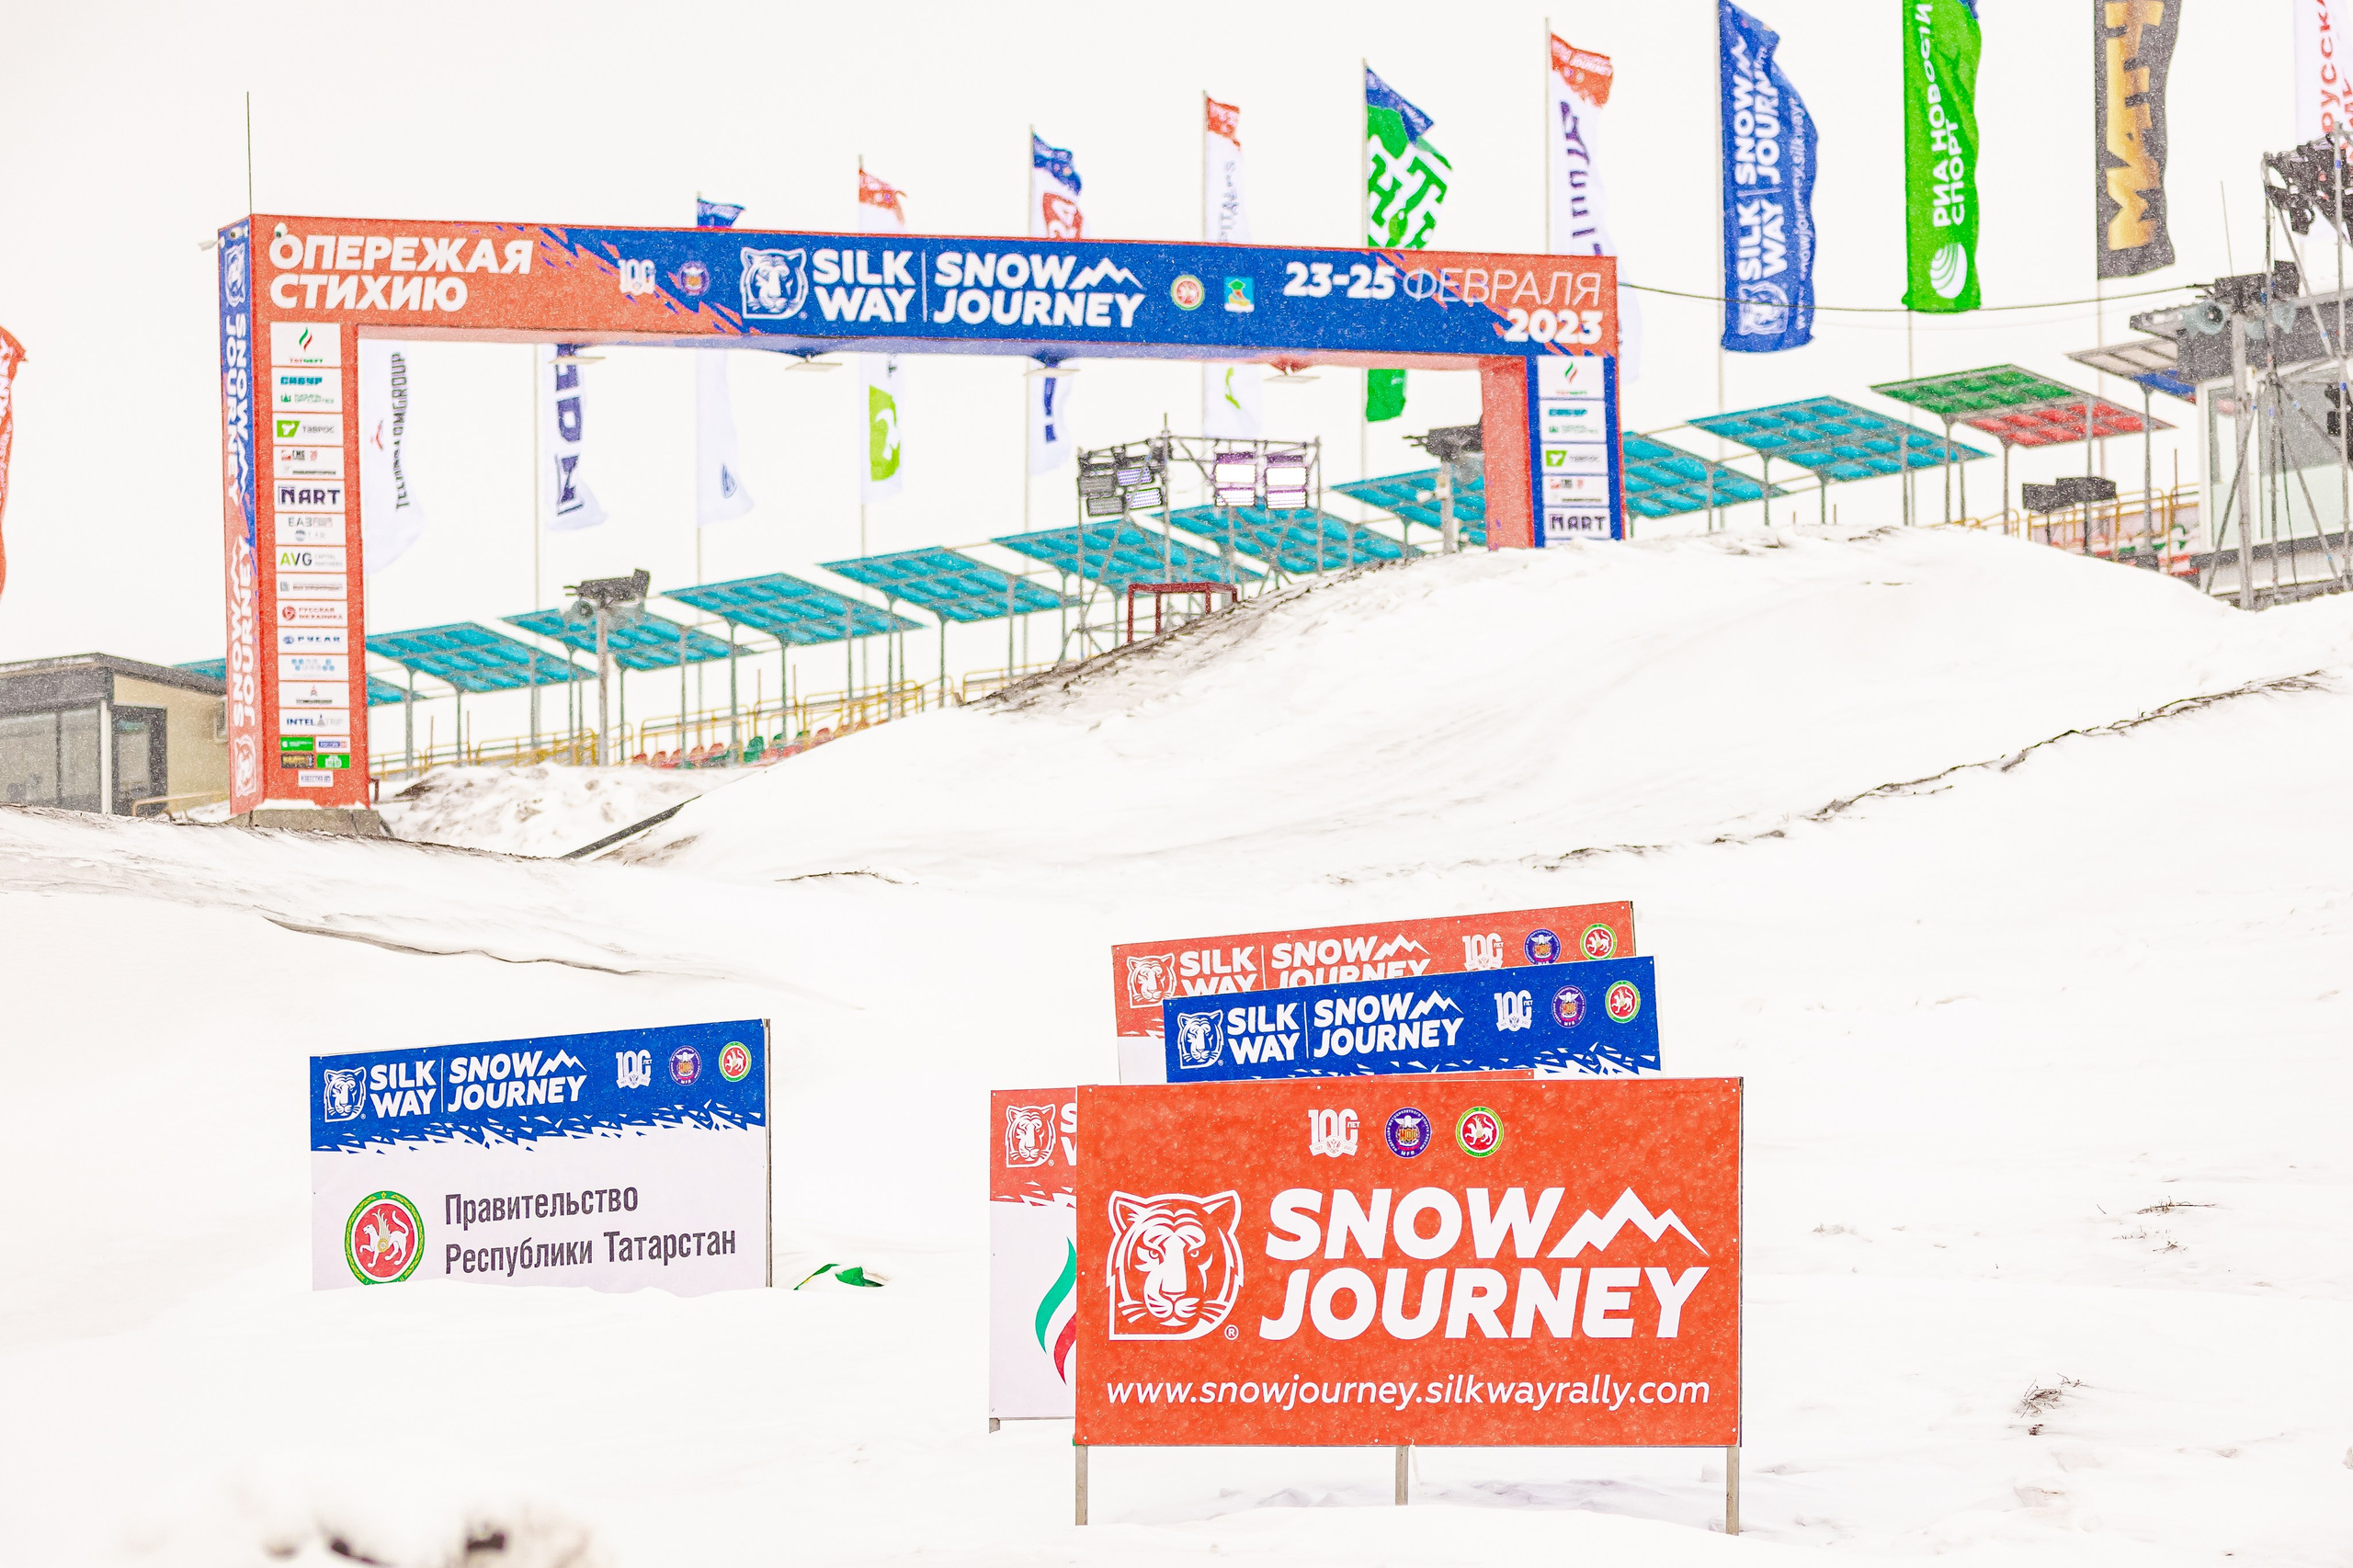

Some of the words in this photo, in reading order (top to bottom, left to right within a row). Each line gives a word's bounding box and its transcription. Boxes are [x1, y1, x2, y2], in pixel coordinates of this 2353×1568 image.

[1734, 75, 1756, 185] SNOW
[1946, 119, 1964, 225] СПОРТ
[1933, 159, 1950, 227] РИА
[268, 234, 533, 274] ОПЕРЕЖАЯ
[1738, 201, 1762, 281] SILK
[1761, 199, 1787, 278] WAY
[813, 248, 916, 285] SILK
[934, 252, 1077, 290] SNOW
[1283, 261, 1396, 301] 23-25
[1403, 267, 1602, 307] ФЕВРАЛЯ
[269, 273, 468, 312] СТИХИЮ
[814, 287, 917, 323] WAY
[933, 288, 1146, 328] JOURNEY
[1504, 308, 1603, 345] 2023
[234, 313, 249, 439] SNOW
[225, 315, 240, 505] JOURNEY
[278, 487, 340, 505] NART
[1550, 514, 1607, 530] NART
[280, 552, 313, 566] AVG
[239, 540, 256, 727] JOURNEY
[231, 600, 244, 728] SNOW
[1179, 946, 1257, 977] SILK
[1271, 936, 1379, 969] SNOW
[1181, 973, 1258, 996] WAY
[1279, 959, 1431, 988] JOURNEY
[1227, 1002, 1301, 1036] SILK
[1313, 992, 1415, 1028] SNOW
[1228, 1032, 1301, 1065] WAY
[1313, 1017, 1464, 1058] JOURNEY
[369, 1060, 437, 1091] SILK
[449, 1051, 543, 1084] SNOW
[371, 1088, 437, 1119] WAY
[448, 1074, 588, 1113] JOURNEY
[1347, 1120, 1360, 1129] ЛЕТ
[445, 1187, 639, 1231] Правительство
[1265, 1187, 1565, 1260] SNOW
[445, 1240, 594, 1279] Республики
[603, 1230, 736, 1267] Татарстан
[1258, 1267, 1710, 1340] JOURNEY
[1107, 1374, 1710, 1411] www.snowjourney.silkwayrally.com
